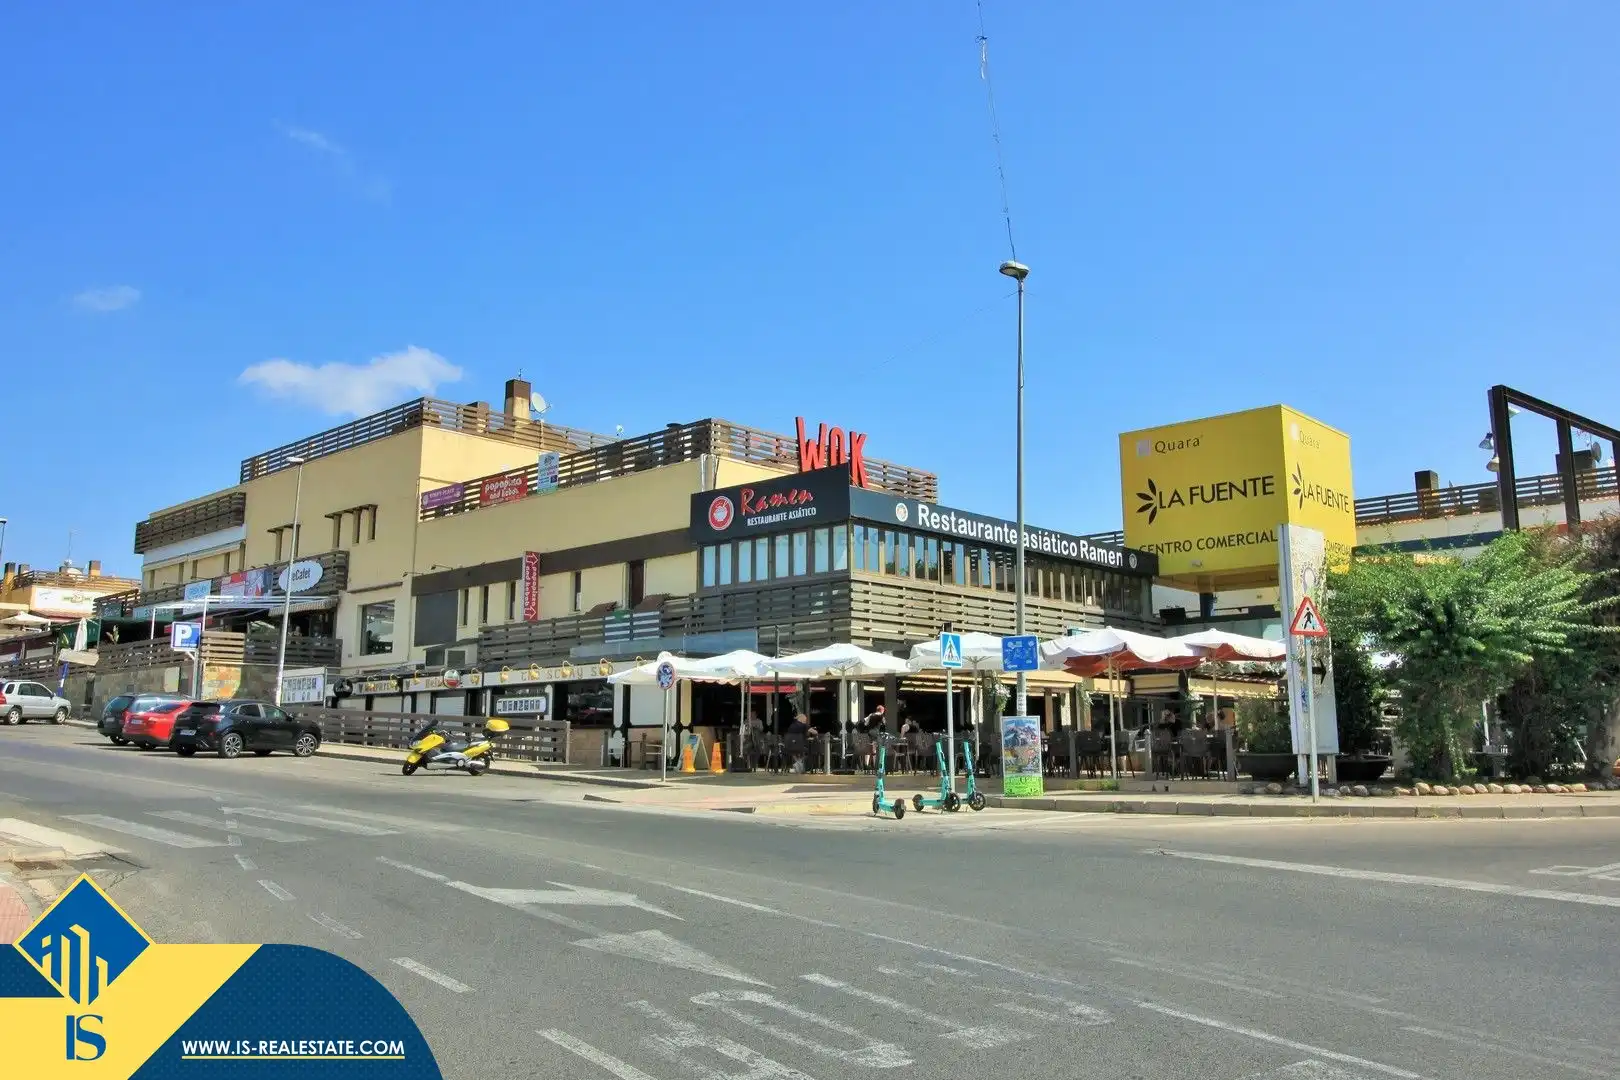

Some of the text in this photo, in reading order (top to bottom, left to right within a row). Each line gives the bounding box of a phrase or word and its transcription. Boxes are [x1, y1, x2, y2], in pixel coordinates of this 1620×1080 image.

[795, 416, 868, 488] WOK
[1154, 437, 1200, 454] Quara
[740, 488, 814, 516] Ramen
[1158, 475, 1275, 509] LA FUENTE
[1302, 479, 1350, 514] LA FUENTE
[746, 507, 817, 527] RESTAURANTE ASIÁTICO
[917, 504, 1123, 566] Restaurante asiático Ramen
[1139, 529, 1278, 555] CENTRO COMERCIAL
